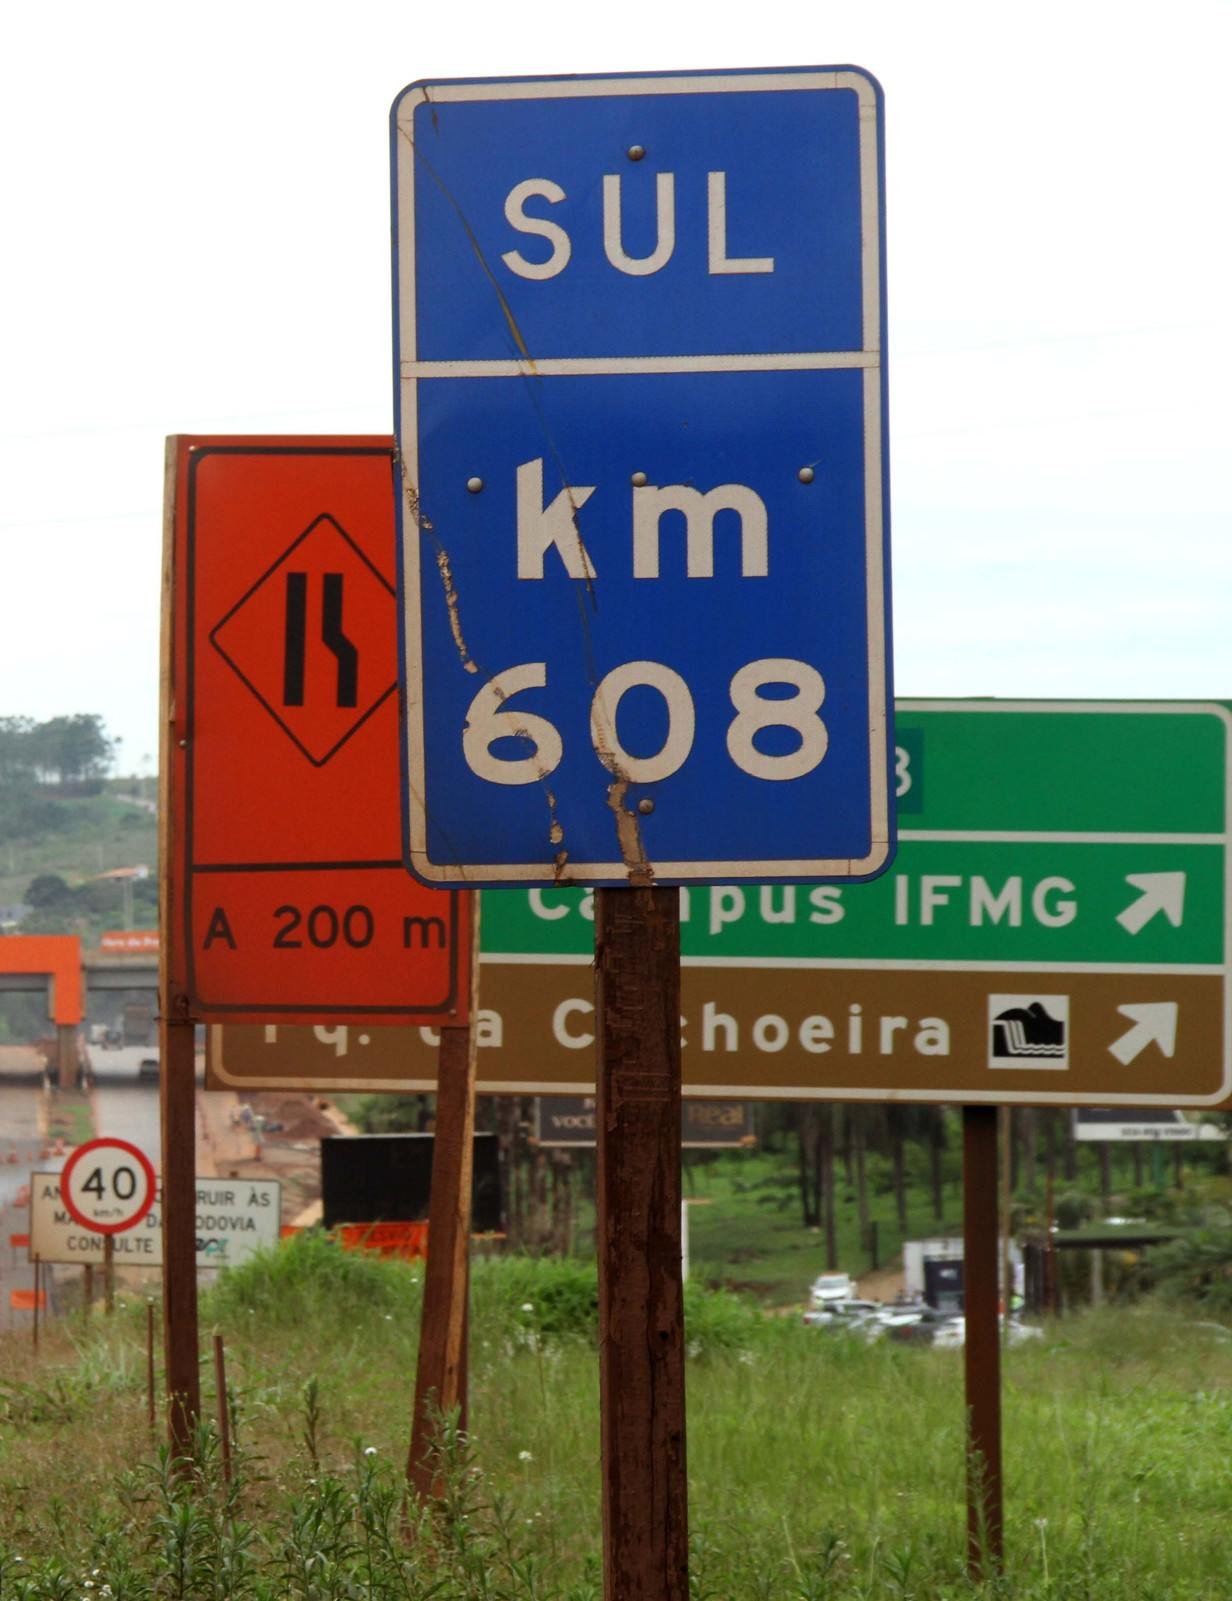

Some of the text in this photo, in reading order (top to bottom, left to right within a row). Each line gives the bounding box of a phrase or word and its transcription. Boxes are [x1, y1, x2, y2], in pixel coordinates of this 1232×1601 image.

[501, 170, 775, 281] SUL
[516, 457, 769, 580] km
[462, 657, 829, 784] 608
[202, 905, 446, 950] A 200 m
[528, 874, 1078, 936] Cpus IFMG
[552, 998, 950, 1056] Choeira
[81, 1166, 136, 1201] 40
[248, 1185, 271, 1207] ÀS
[69, 1235, 153, 1254] CONULTE
[196, 1215, 256, 1232] ODOVIA
